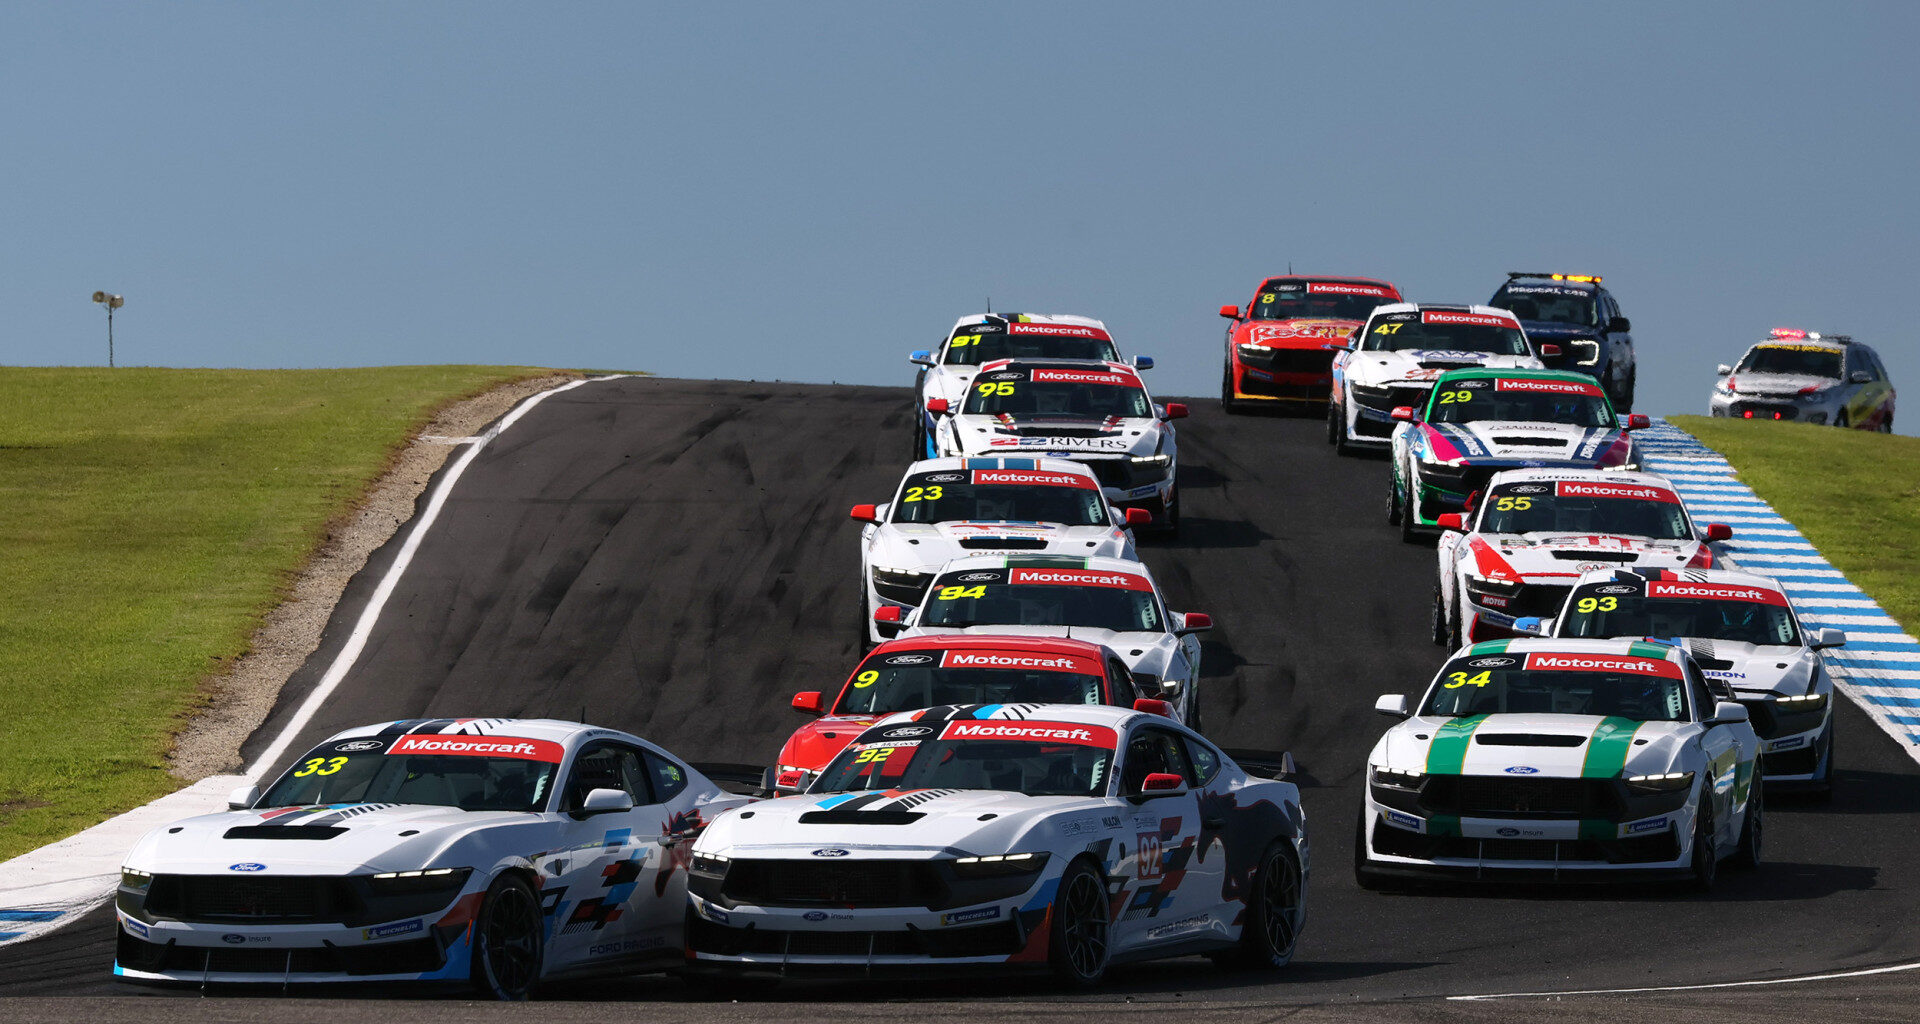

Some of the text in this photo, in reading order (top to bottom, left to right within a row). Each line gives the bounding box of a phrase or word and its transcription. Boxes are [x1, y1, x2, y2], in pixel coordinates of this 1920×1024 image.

[1313, 285, 1383, 295] Motorcraft
[1261, 293, 1276, 304] 8
[1429, 314, 1502, 325] Motorcraft
[1015, 326, 1093, 336] Motorcraft
[1374, 323, 1404, 335] 47
[950, 335, 982, 348] 91
[1039, 372, 1122, 383] Motorcraft
[978, 382, 1015, 398] 95
[1503, 381, 1585, 392] Motorcraft
[1440, 391, 1472, 404] 29
[1051, 437, 1127, 449] RIVERS
[981, 473, 1077, 485] Motorcraft
[904, 485, 943, 503] 23
[1565, 485, 1659, 498] Motorcraft
[1497, 496, 1532, 512] 55
[1020, 572, 1128, 585] Motorcraft
[939, 585, 986, 600] 94
[1656, 585, 1763, 600] Motorcraft
[1482, 596, 1506, 606] MOTUL
[1578, 596, 1618, 614] 93
[952, 654, 1074, 669] Motorcraft
[1536, 657, 1654, 672] Motorcraft
[853, 671, 880, 689] 9
[1443, 670, 1491, 688] 34
[954, 724, 1091, 740] Motorcraft
[402, 739, 532, 756] Motorcraft
[854, 748, 896, 763] 92
[293, 757, 349, 778] 33
[1522, 828, 1544, 837] Insure
[1141, 836, 1160, 877] 92
[830, 912, 855, 921] Insure
[957, 909, 996, 922] MICHELIN
[379, 922, 418, 937] MICHELIN
[247, 934, 272, 943] Insure
[590, 937, 667, 955] FORD RACING
